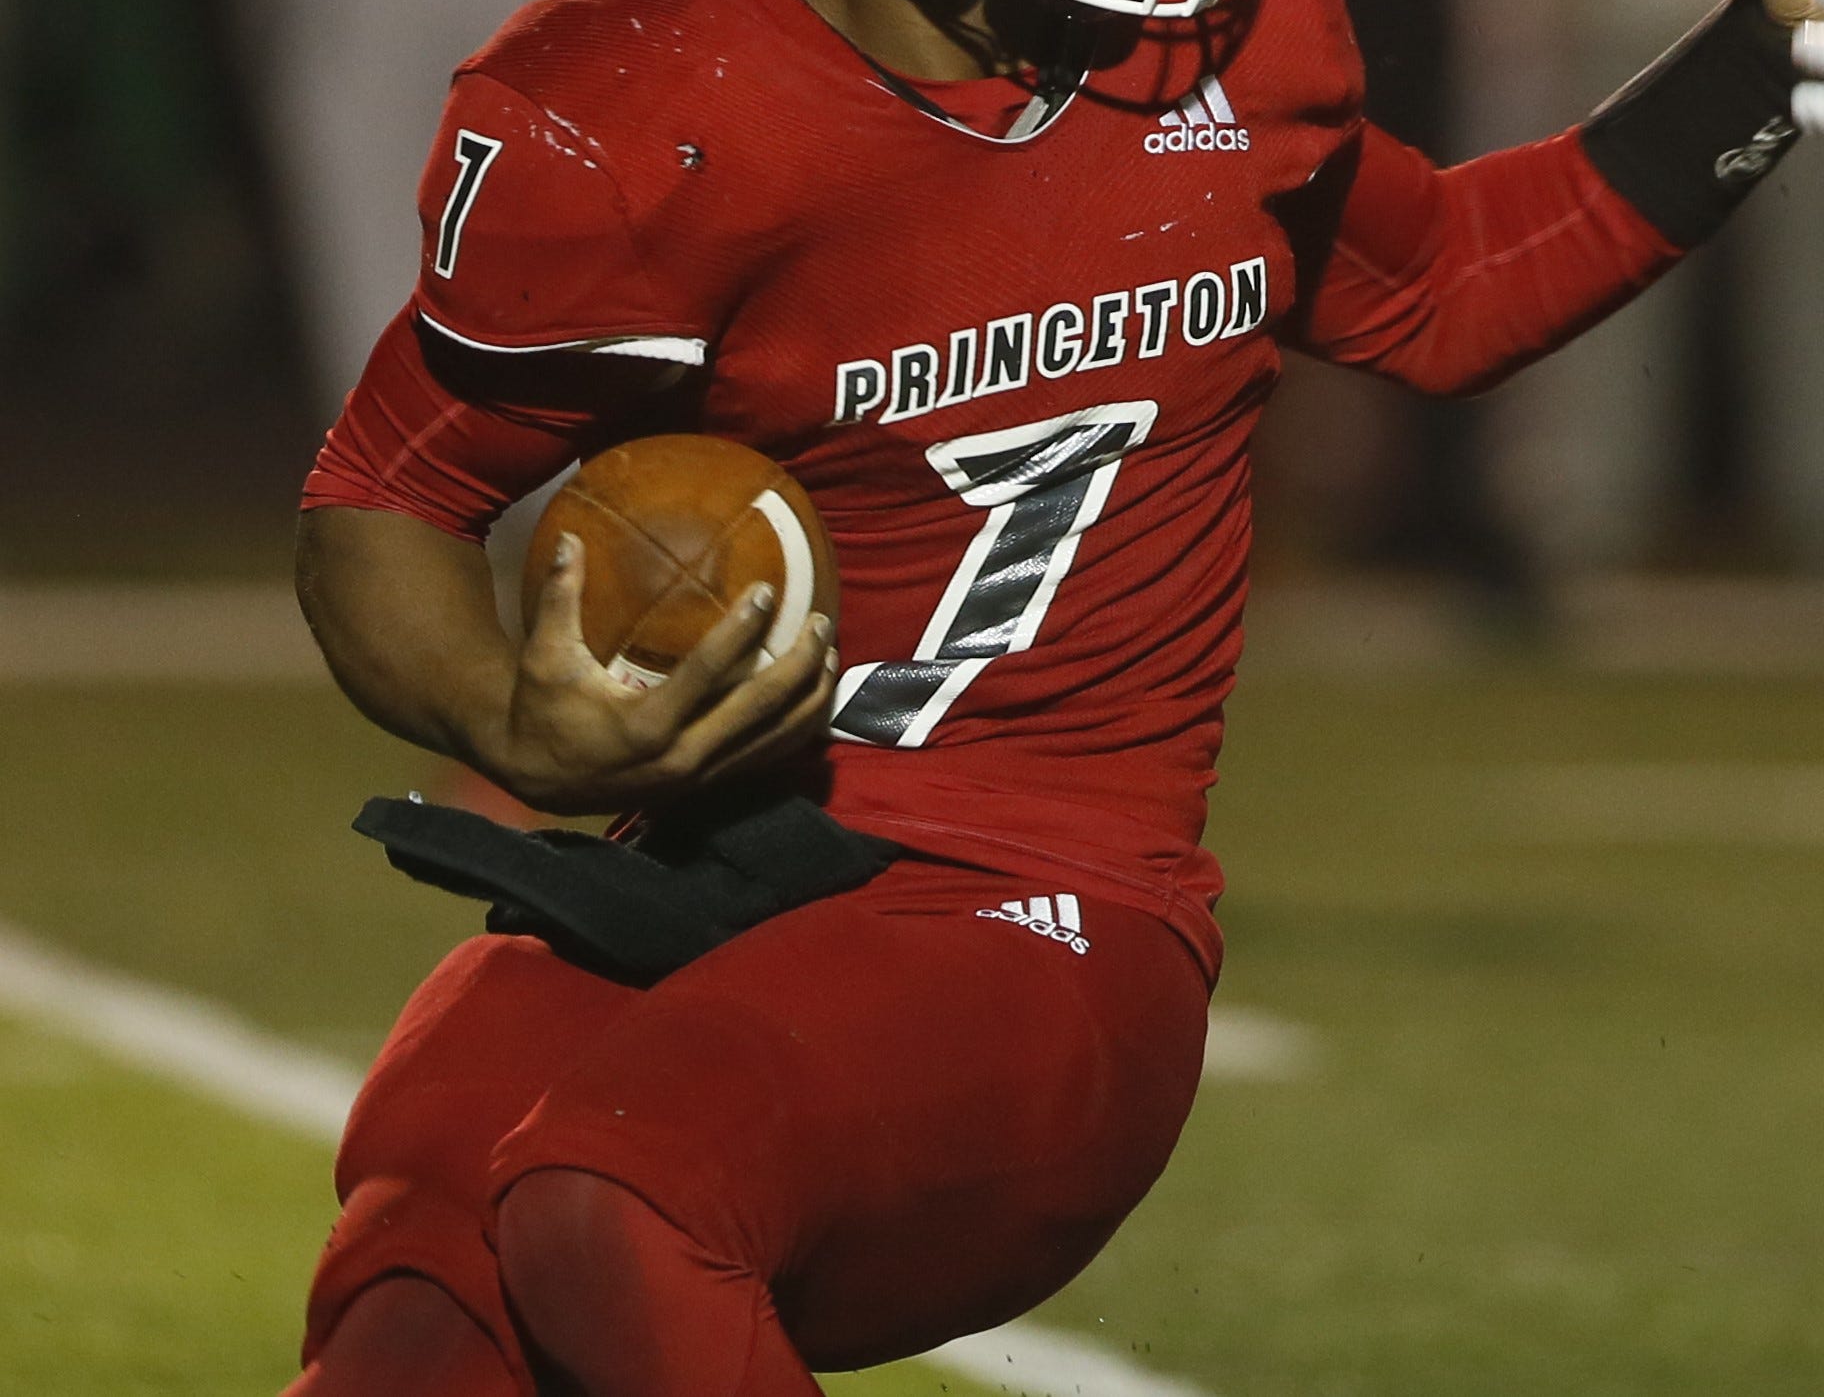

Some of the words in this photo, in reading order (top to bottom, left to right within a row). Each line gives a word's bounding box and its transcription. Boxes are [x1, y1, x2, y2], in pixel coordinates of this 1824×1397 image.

[434, 129, 502, 280] 7
[1144, 122, 1250, 154] adidas
[833, 257, 1268, 426] PRINCETON
[831, 399, 1160, 748] 7
[975, 908, 1091, 955] adidas
